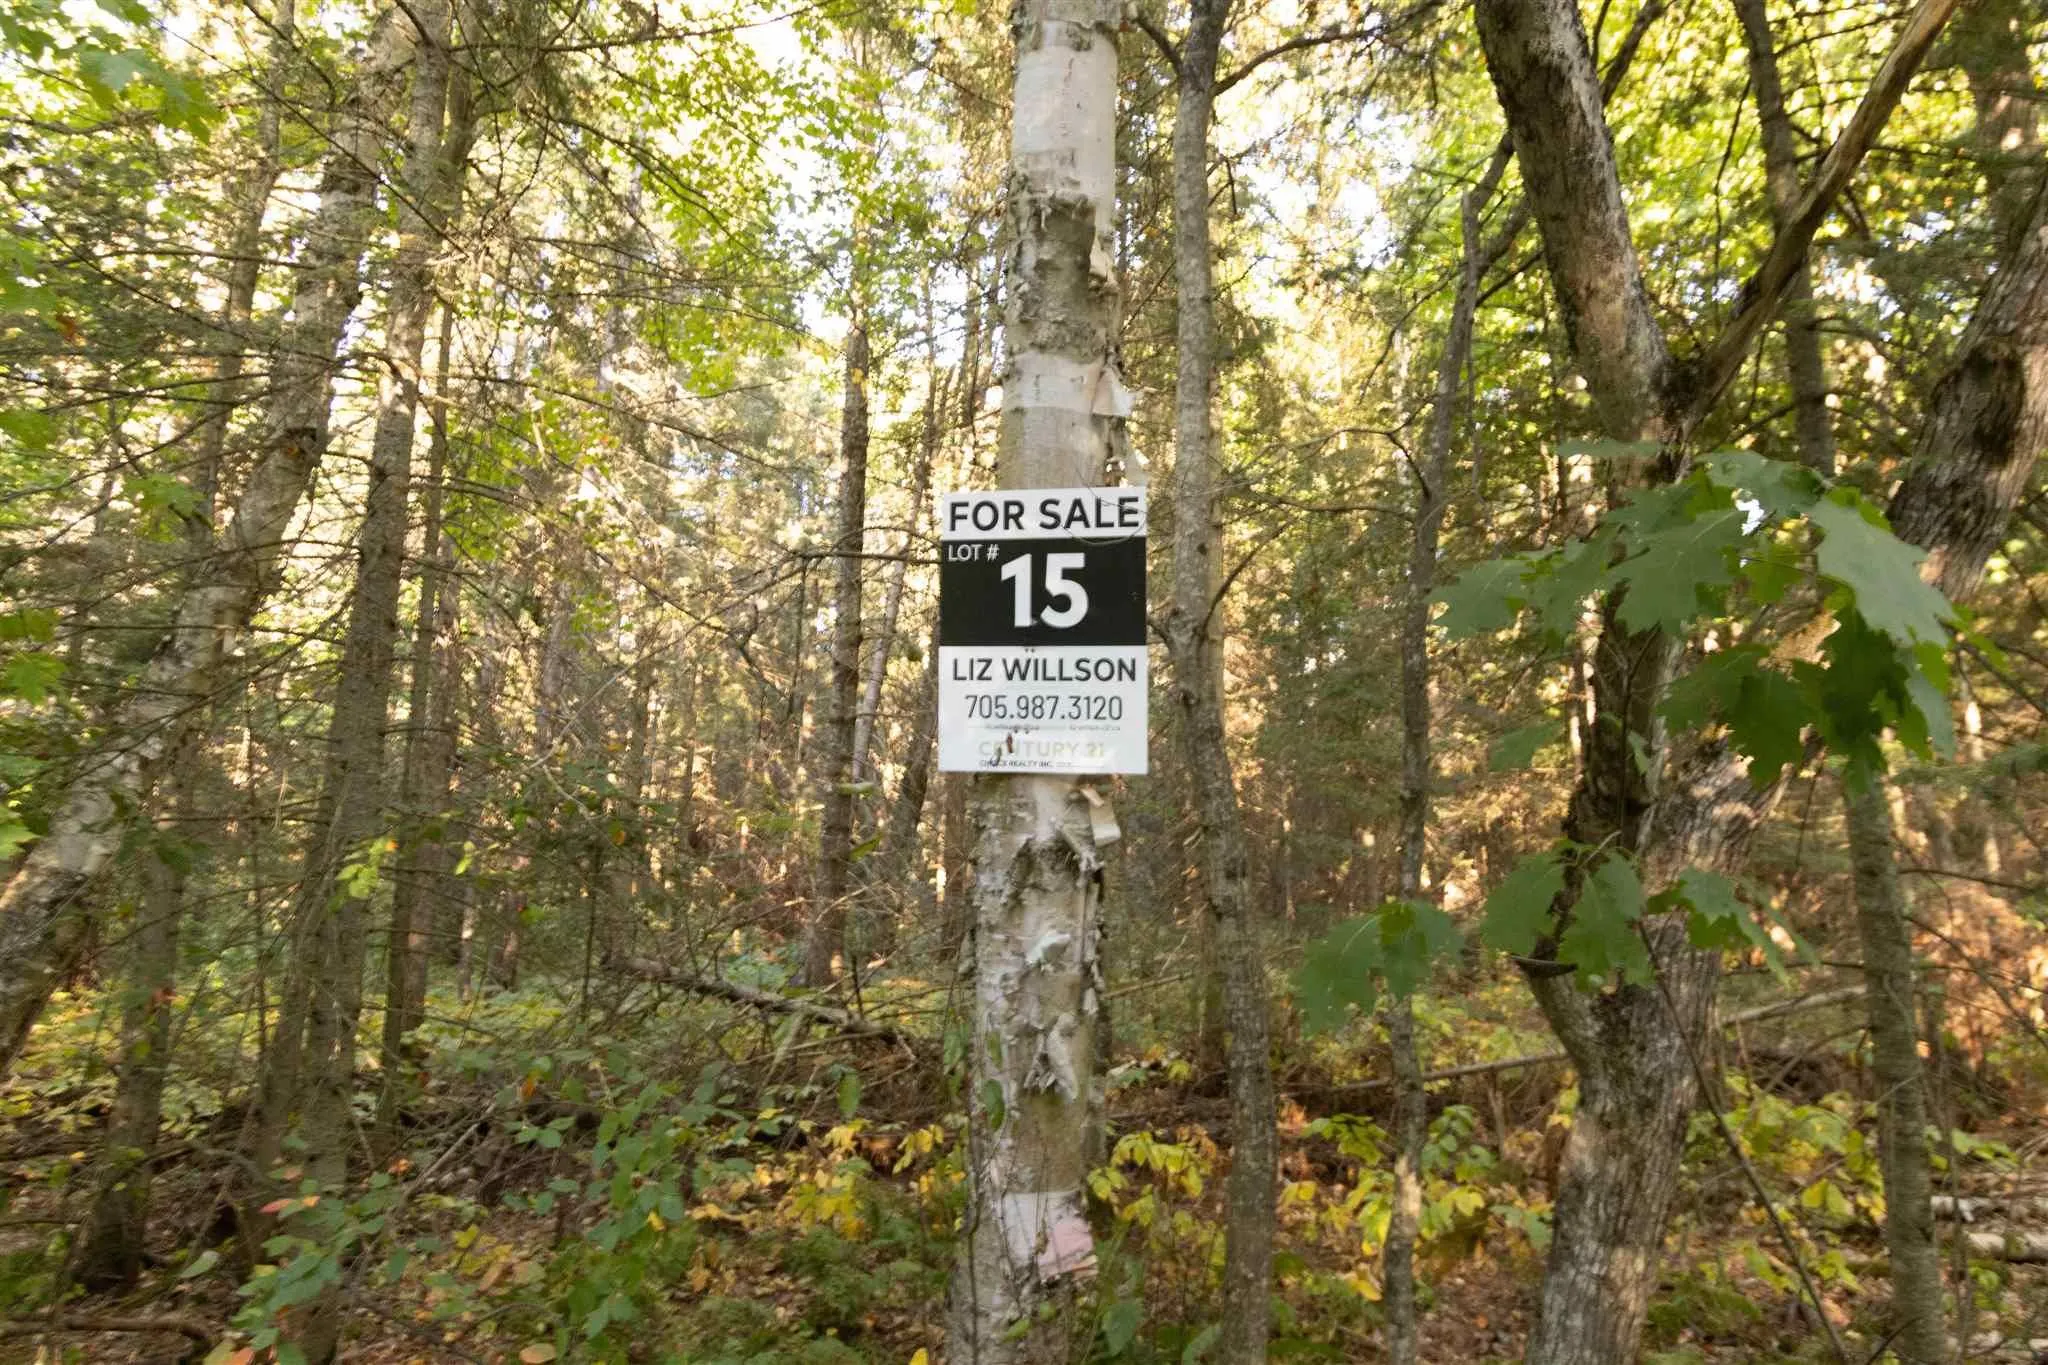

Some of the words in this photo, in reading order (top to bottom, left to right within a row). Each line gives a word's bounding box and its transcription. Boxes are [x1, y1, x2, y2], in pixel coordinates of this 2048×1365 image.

[949, 500, 1025, 532] FOR
[1039, 496, 1140, 530] SALE
[948, 544, 984, 562] LOT
[986, 545, 1000, 561] #
[1001, 552, 1089, 629] 15
[953, 658, 993, 681] LIZ
[1003, 657, 1137, 682] WILLSON
[965, 694, 1123, 721] 705.987.3120
[978, 740, 1080, 757] CTURY
